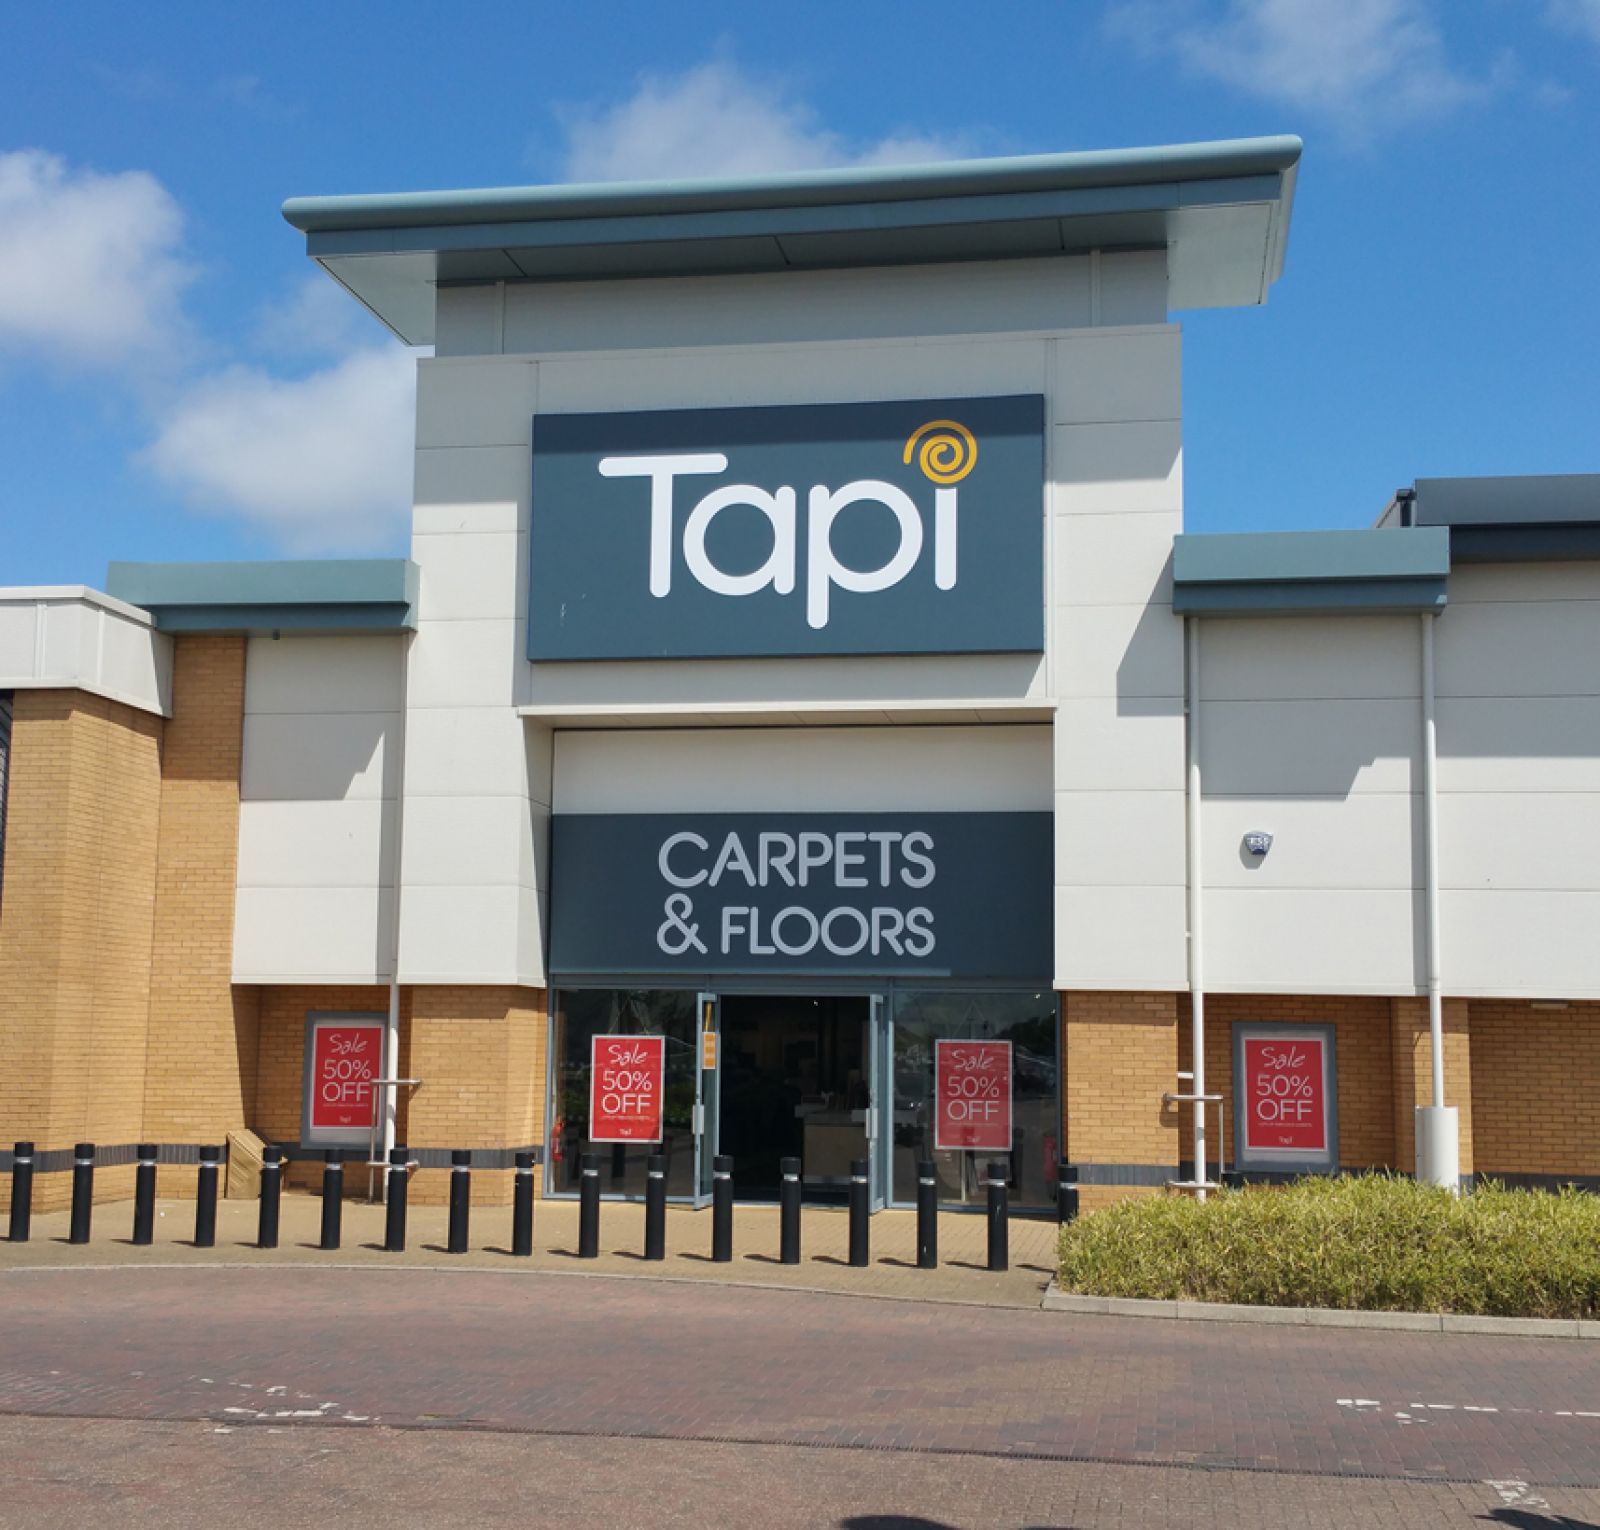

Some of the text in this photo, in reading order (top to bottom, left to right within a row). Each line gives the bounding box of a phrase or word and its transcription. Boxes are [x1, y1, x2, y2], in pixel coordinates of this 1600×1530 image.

[598, 419, 978, 630] Tapi
[658, 831, 937, 889] CARPETS
[656, 892, 937, 957] & FLOORS
[329, 1032, 369, 1055] Sale
[608, 1043, 648, 1066] Sale
[951, 1047, 995, 1072] Sale
[1261, 1045, 1306, 1070] Sale
[322, 1059, 372, 1080] 50%
[602, 1070, 653, 1092] 50%
[322, 1081, 371, 1102] OFF
[947, 1075, 1000, 1098] 50%
[1255, 1073, 1314, 1097] 50%
[601, 1093, 653, 1114] OFF
[946, 1099, 1001, 1121] OFF
[1256, 1098, 1313, 1121] OFF
